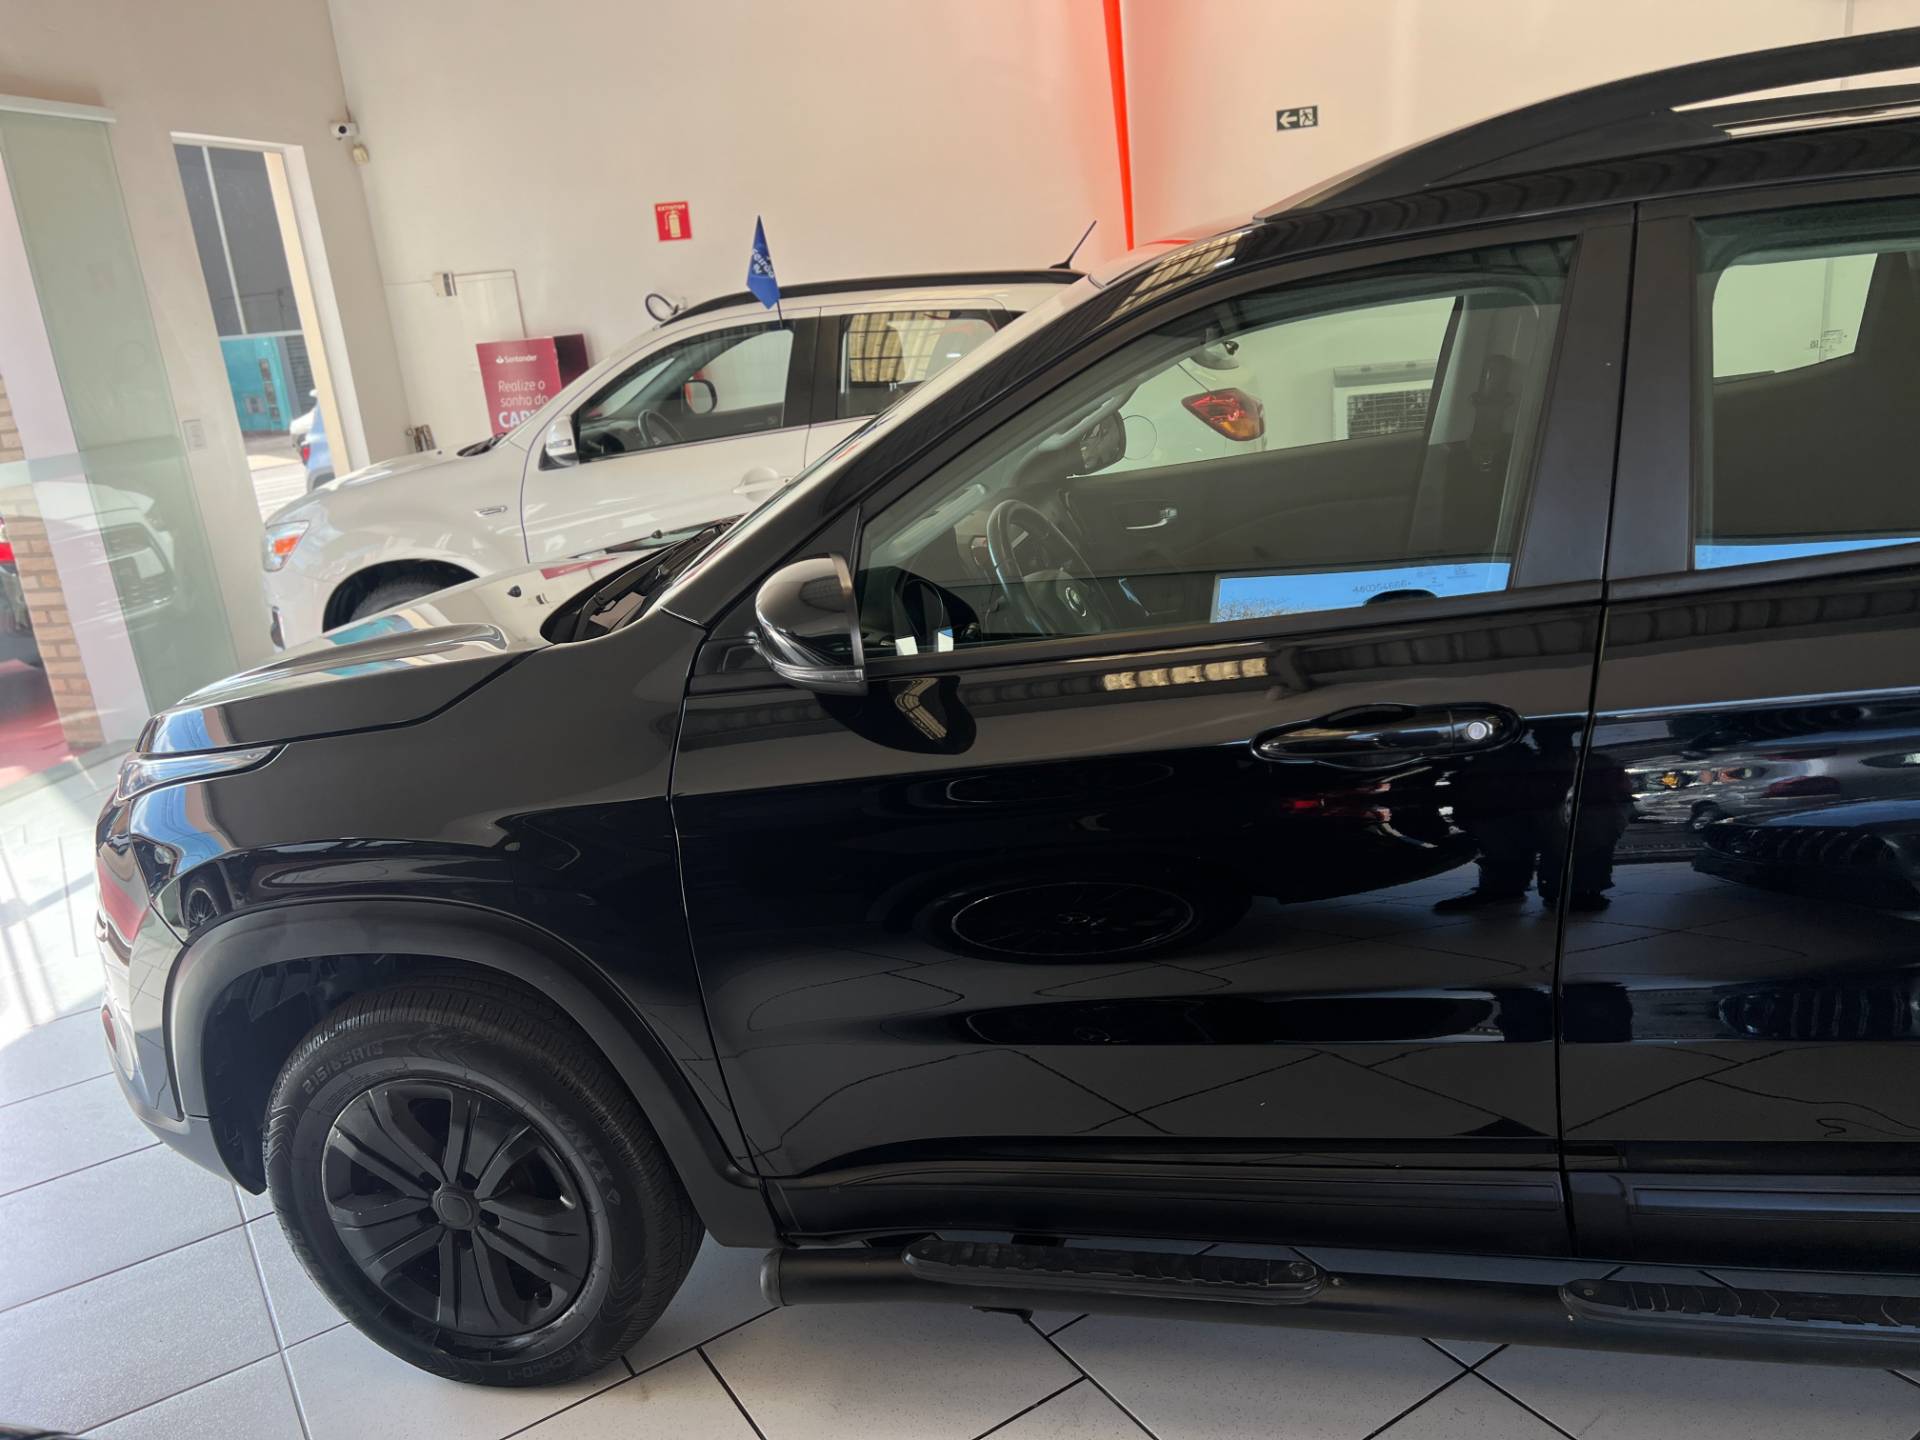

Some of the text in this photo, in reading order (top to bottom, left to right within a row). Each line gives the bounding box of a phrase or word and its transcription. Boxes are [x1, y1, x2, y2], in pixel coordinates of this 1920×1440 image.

[504, 355, 537, 364] Santander
[498, 380, 546, 393] Realize o
[500, 393, 549, 407] sonho do
